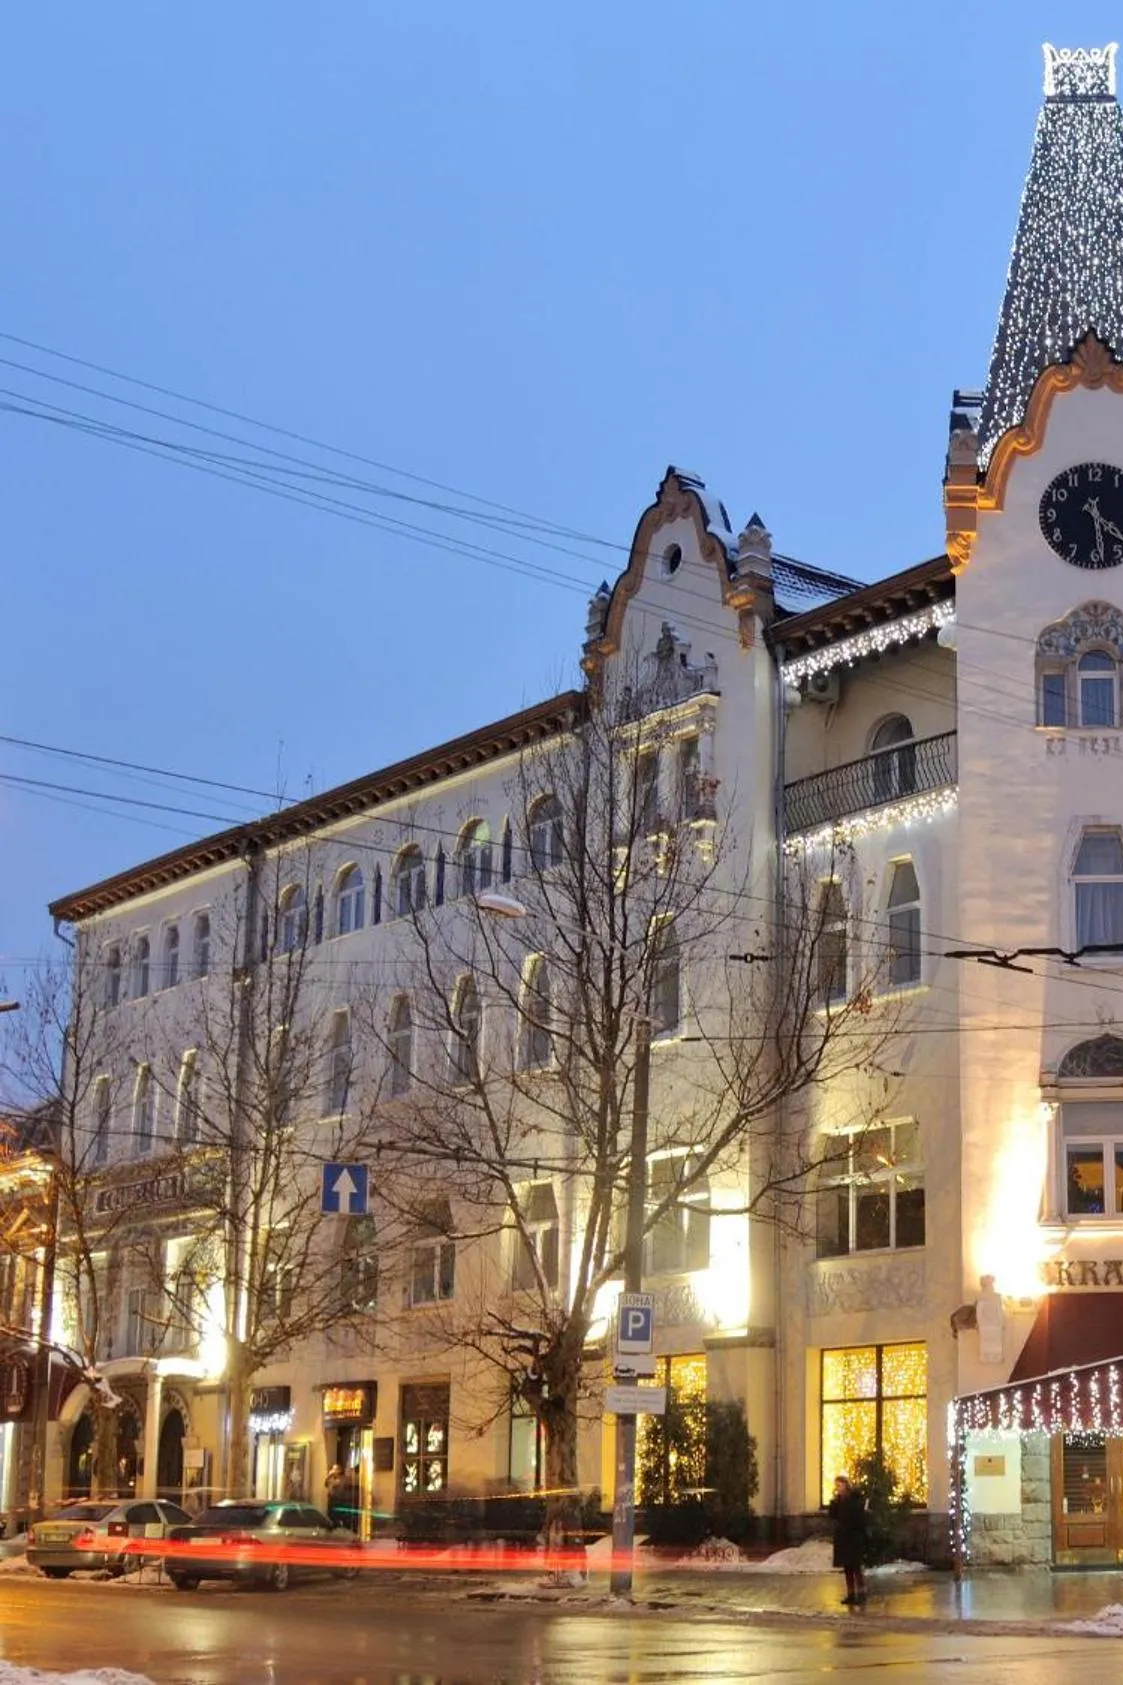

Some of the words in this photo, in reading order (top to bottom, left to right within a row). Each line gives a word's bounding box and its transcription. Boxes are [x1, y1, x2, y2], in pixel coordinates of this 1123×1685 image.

[1069, 474, 1078, 487] 11
[1088, 468, 1103, 482] 12
[1114, 474, 1119, 488] 1
[1052, 489, 1067, 502] 10
[1046, 508, 1056, 523] 9
[1053, 528, 1062, 542] 8
[1069, 544, 1077, 557] 7
[1091, 549, 1100, 562] 6
[1113, 545, 1122, 558] 5
